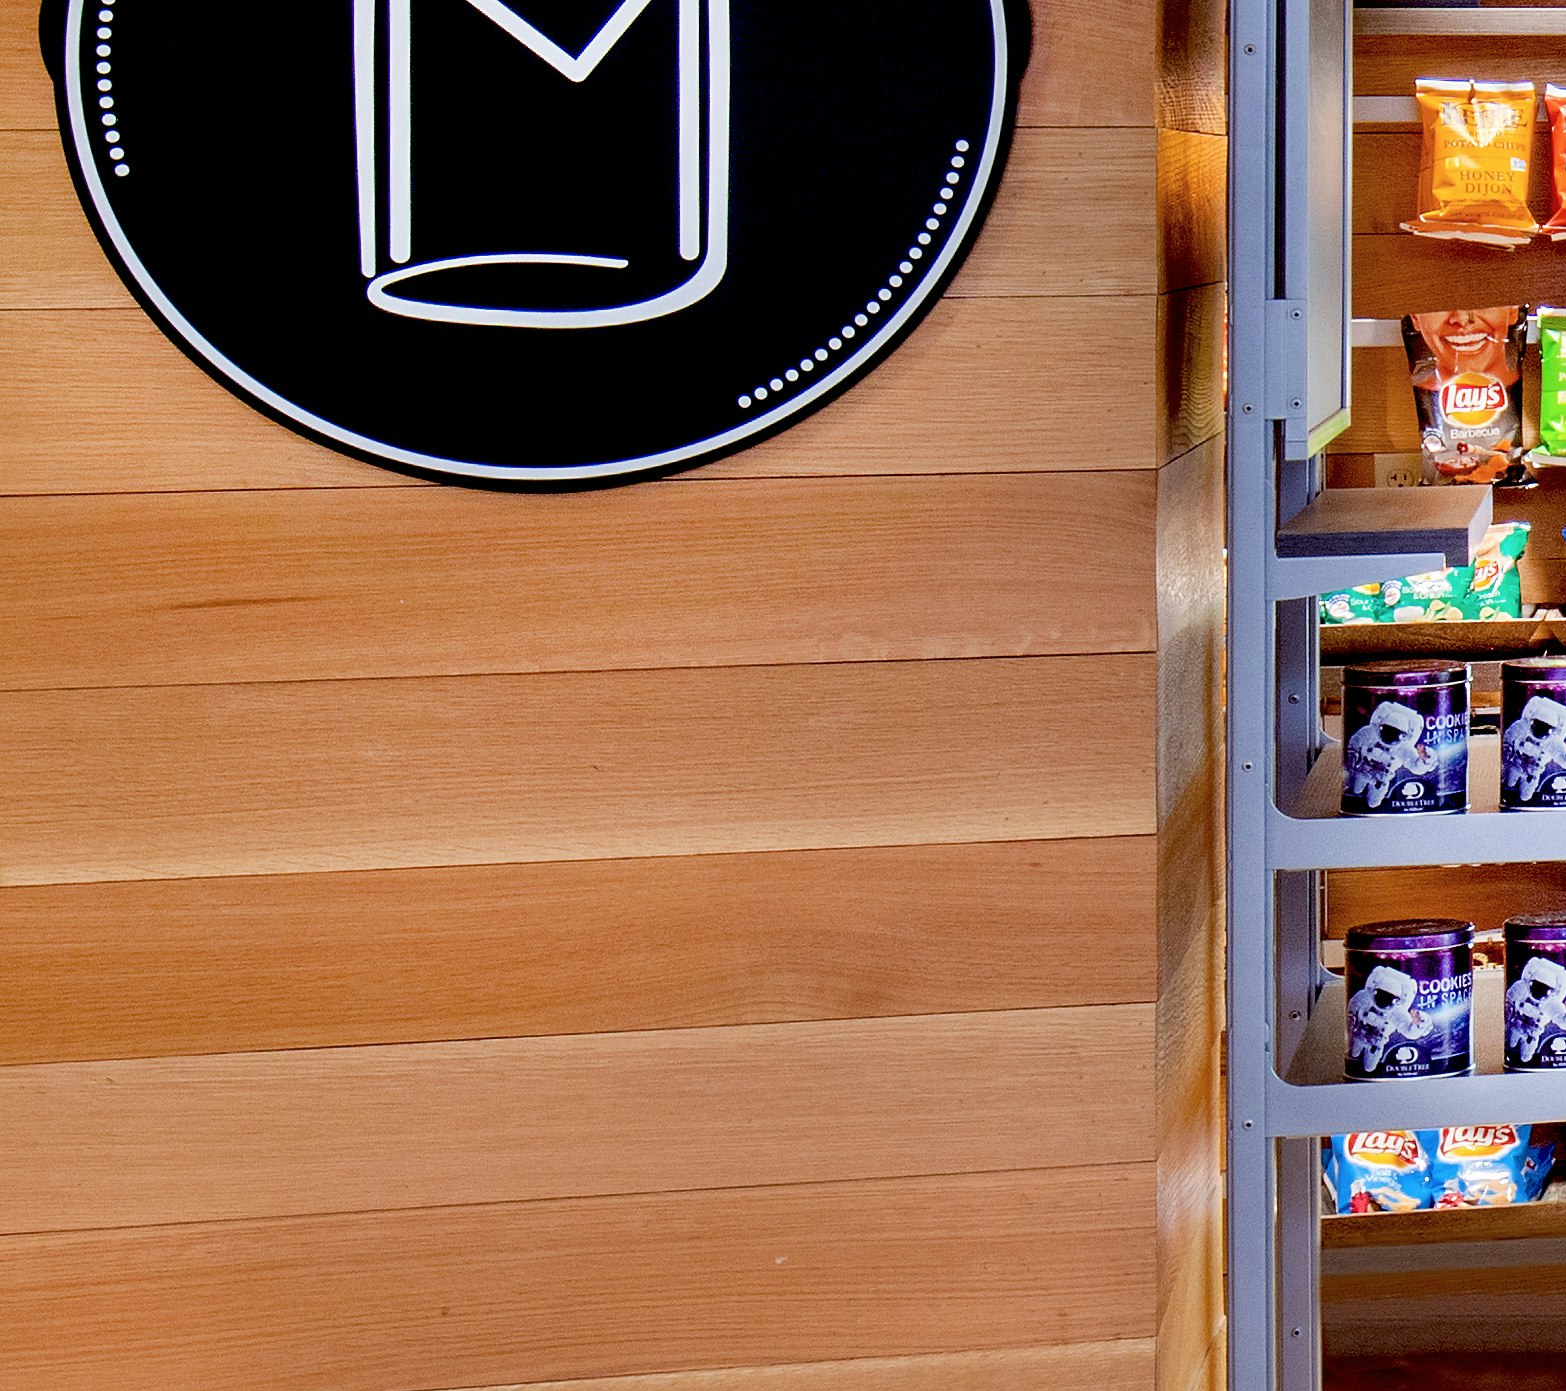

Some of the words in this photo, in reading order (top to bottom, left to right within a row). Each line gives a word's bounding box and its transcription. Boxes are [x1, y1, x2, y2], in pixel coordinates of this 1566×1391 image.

[1460, 170, 1515, 184] HONEY
[1465, 183, 1512, 196] DIJON
[1446, 382, 1506, 413] Lay's
[1450, 427, 1501, 440] Barbecue
